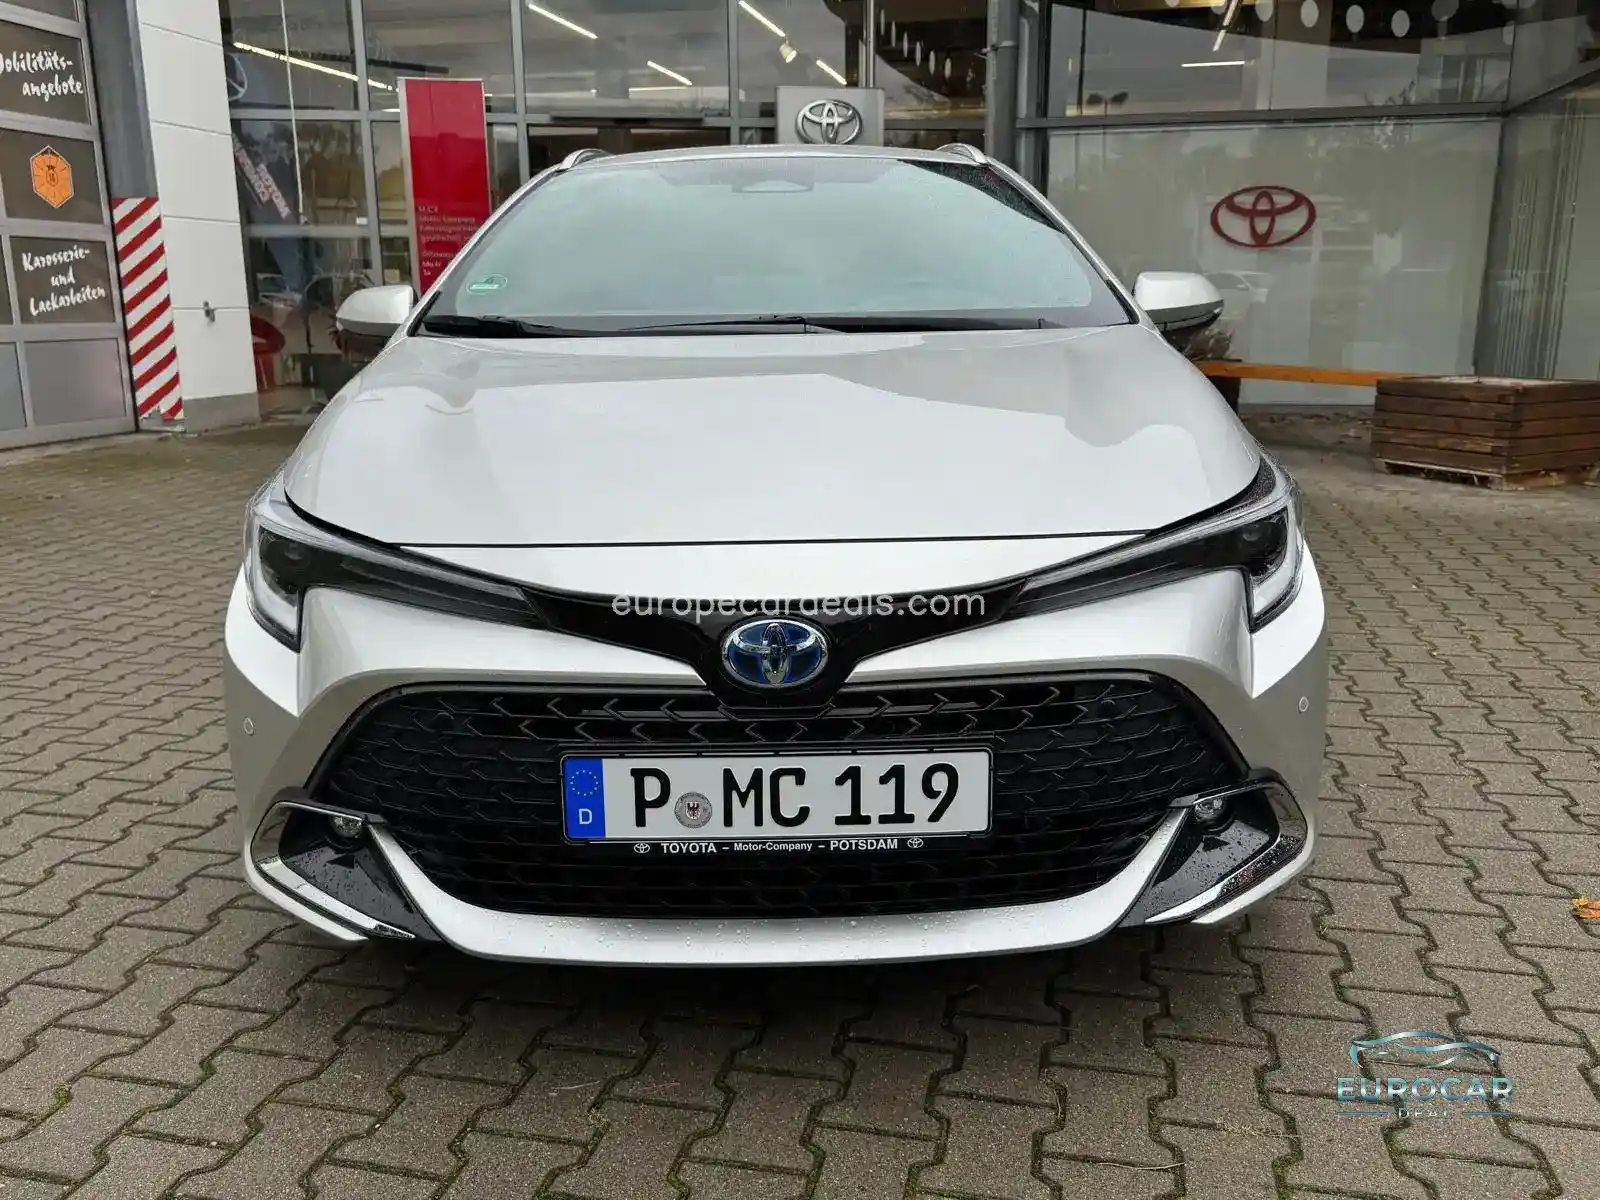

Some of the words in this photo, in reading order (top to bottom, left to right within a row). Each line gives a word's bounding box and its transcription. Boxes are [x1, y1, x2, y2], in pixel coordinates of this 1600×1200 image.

[22, 73, 84, 102] angebote
[21, 244, 91, 272] Karosserie-
[51, 265, 76, 287] und
[29, 284, 106, 317] Lackarbeiten
[630, 767, 671, 828] P
[722, 766, 811, 828] MC
[834, 762, 960, 826] 119
[578, 808, 593, 825] D
[660, 842, 718, 854] TOYOTA
[733, 841, 813, 852] Motor-Company
[829, 838, 899, 851] POTSDAM
